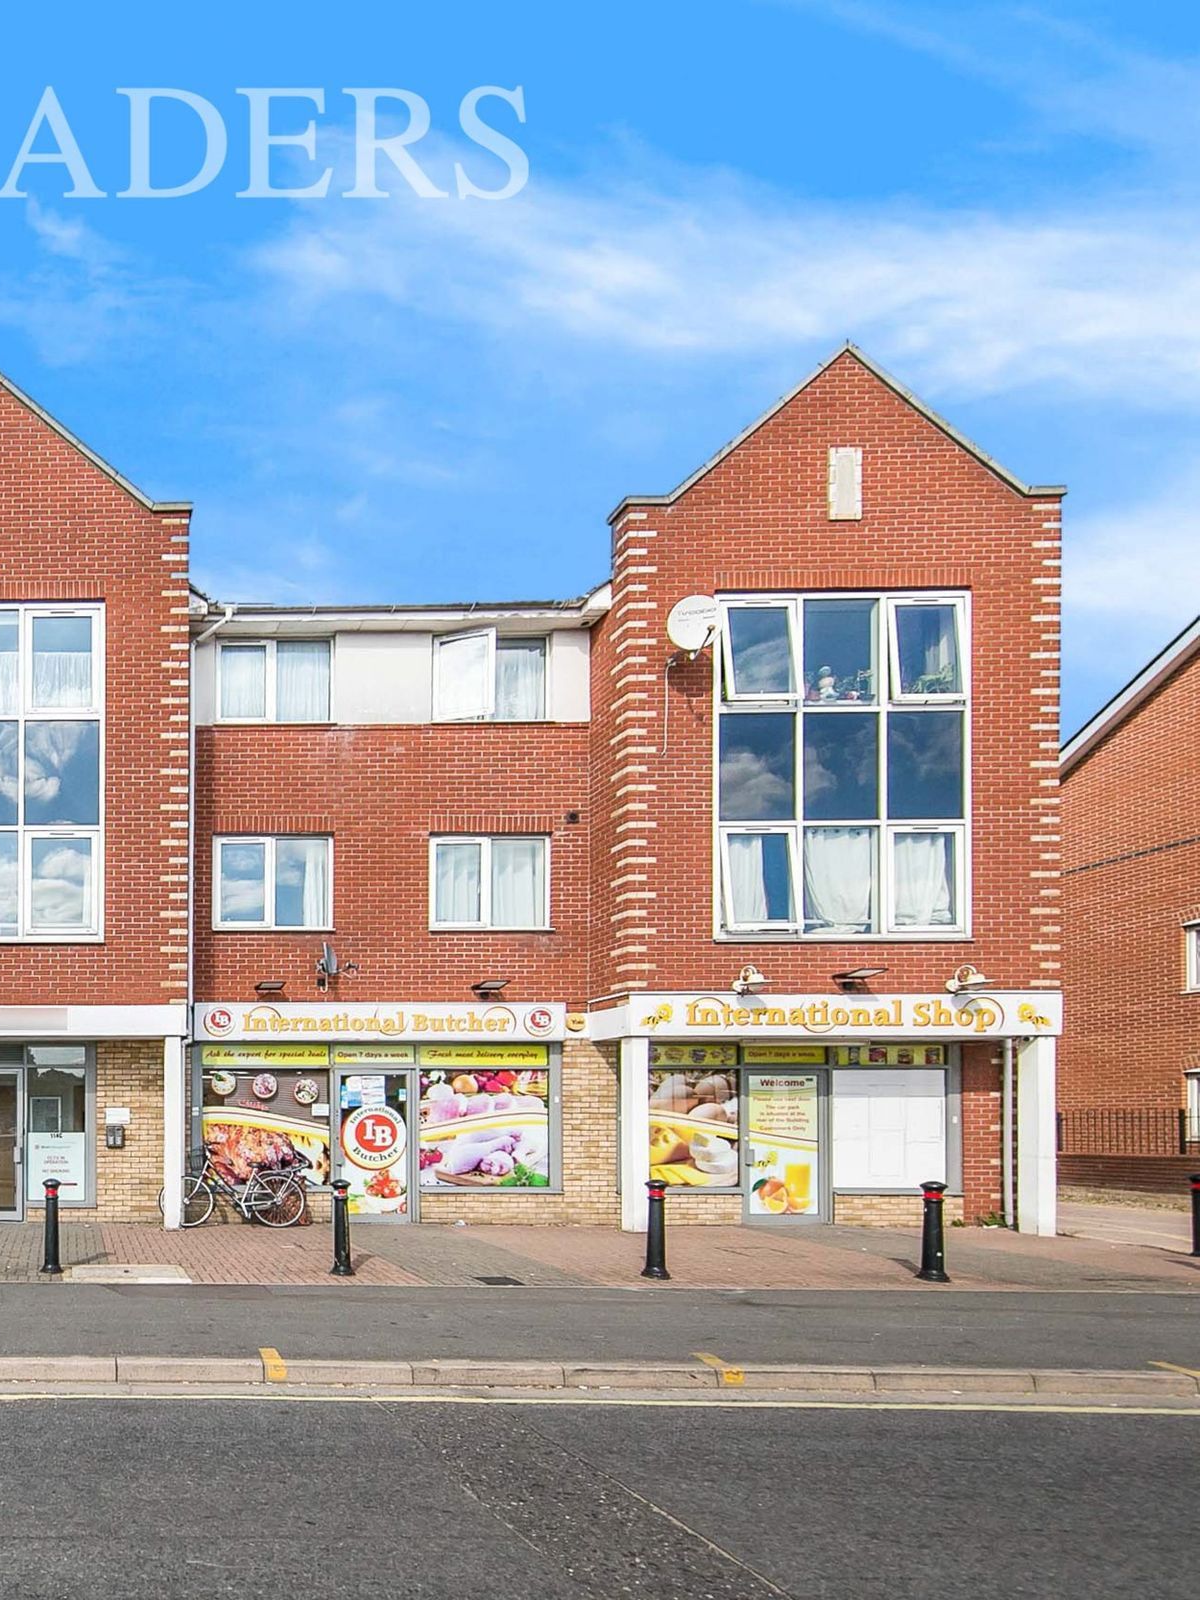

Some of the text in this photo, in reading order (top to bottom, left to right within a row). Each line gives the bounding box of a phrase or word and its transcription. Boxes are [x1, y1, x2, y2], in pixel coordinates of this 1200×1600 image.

[242, 1011, 510, 1033] International Butcher
[685, 999, 997, 1033] International Shop
[206, 1049, 221, 1057] Ask
[279, 1050, 305, 1059] special
[337, 1051, 357, 1059] Open
[364, 1051, 381, 1059] days
[760, 1079, 805, 1087] Welcome
[350, 1106, 402, 1125] International
[362, 1118, 394, 1147] IB
[352, 1145, 399, 1163] Butcher
